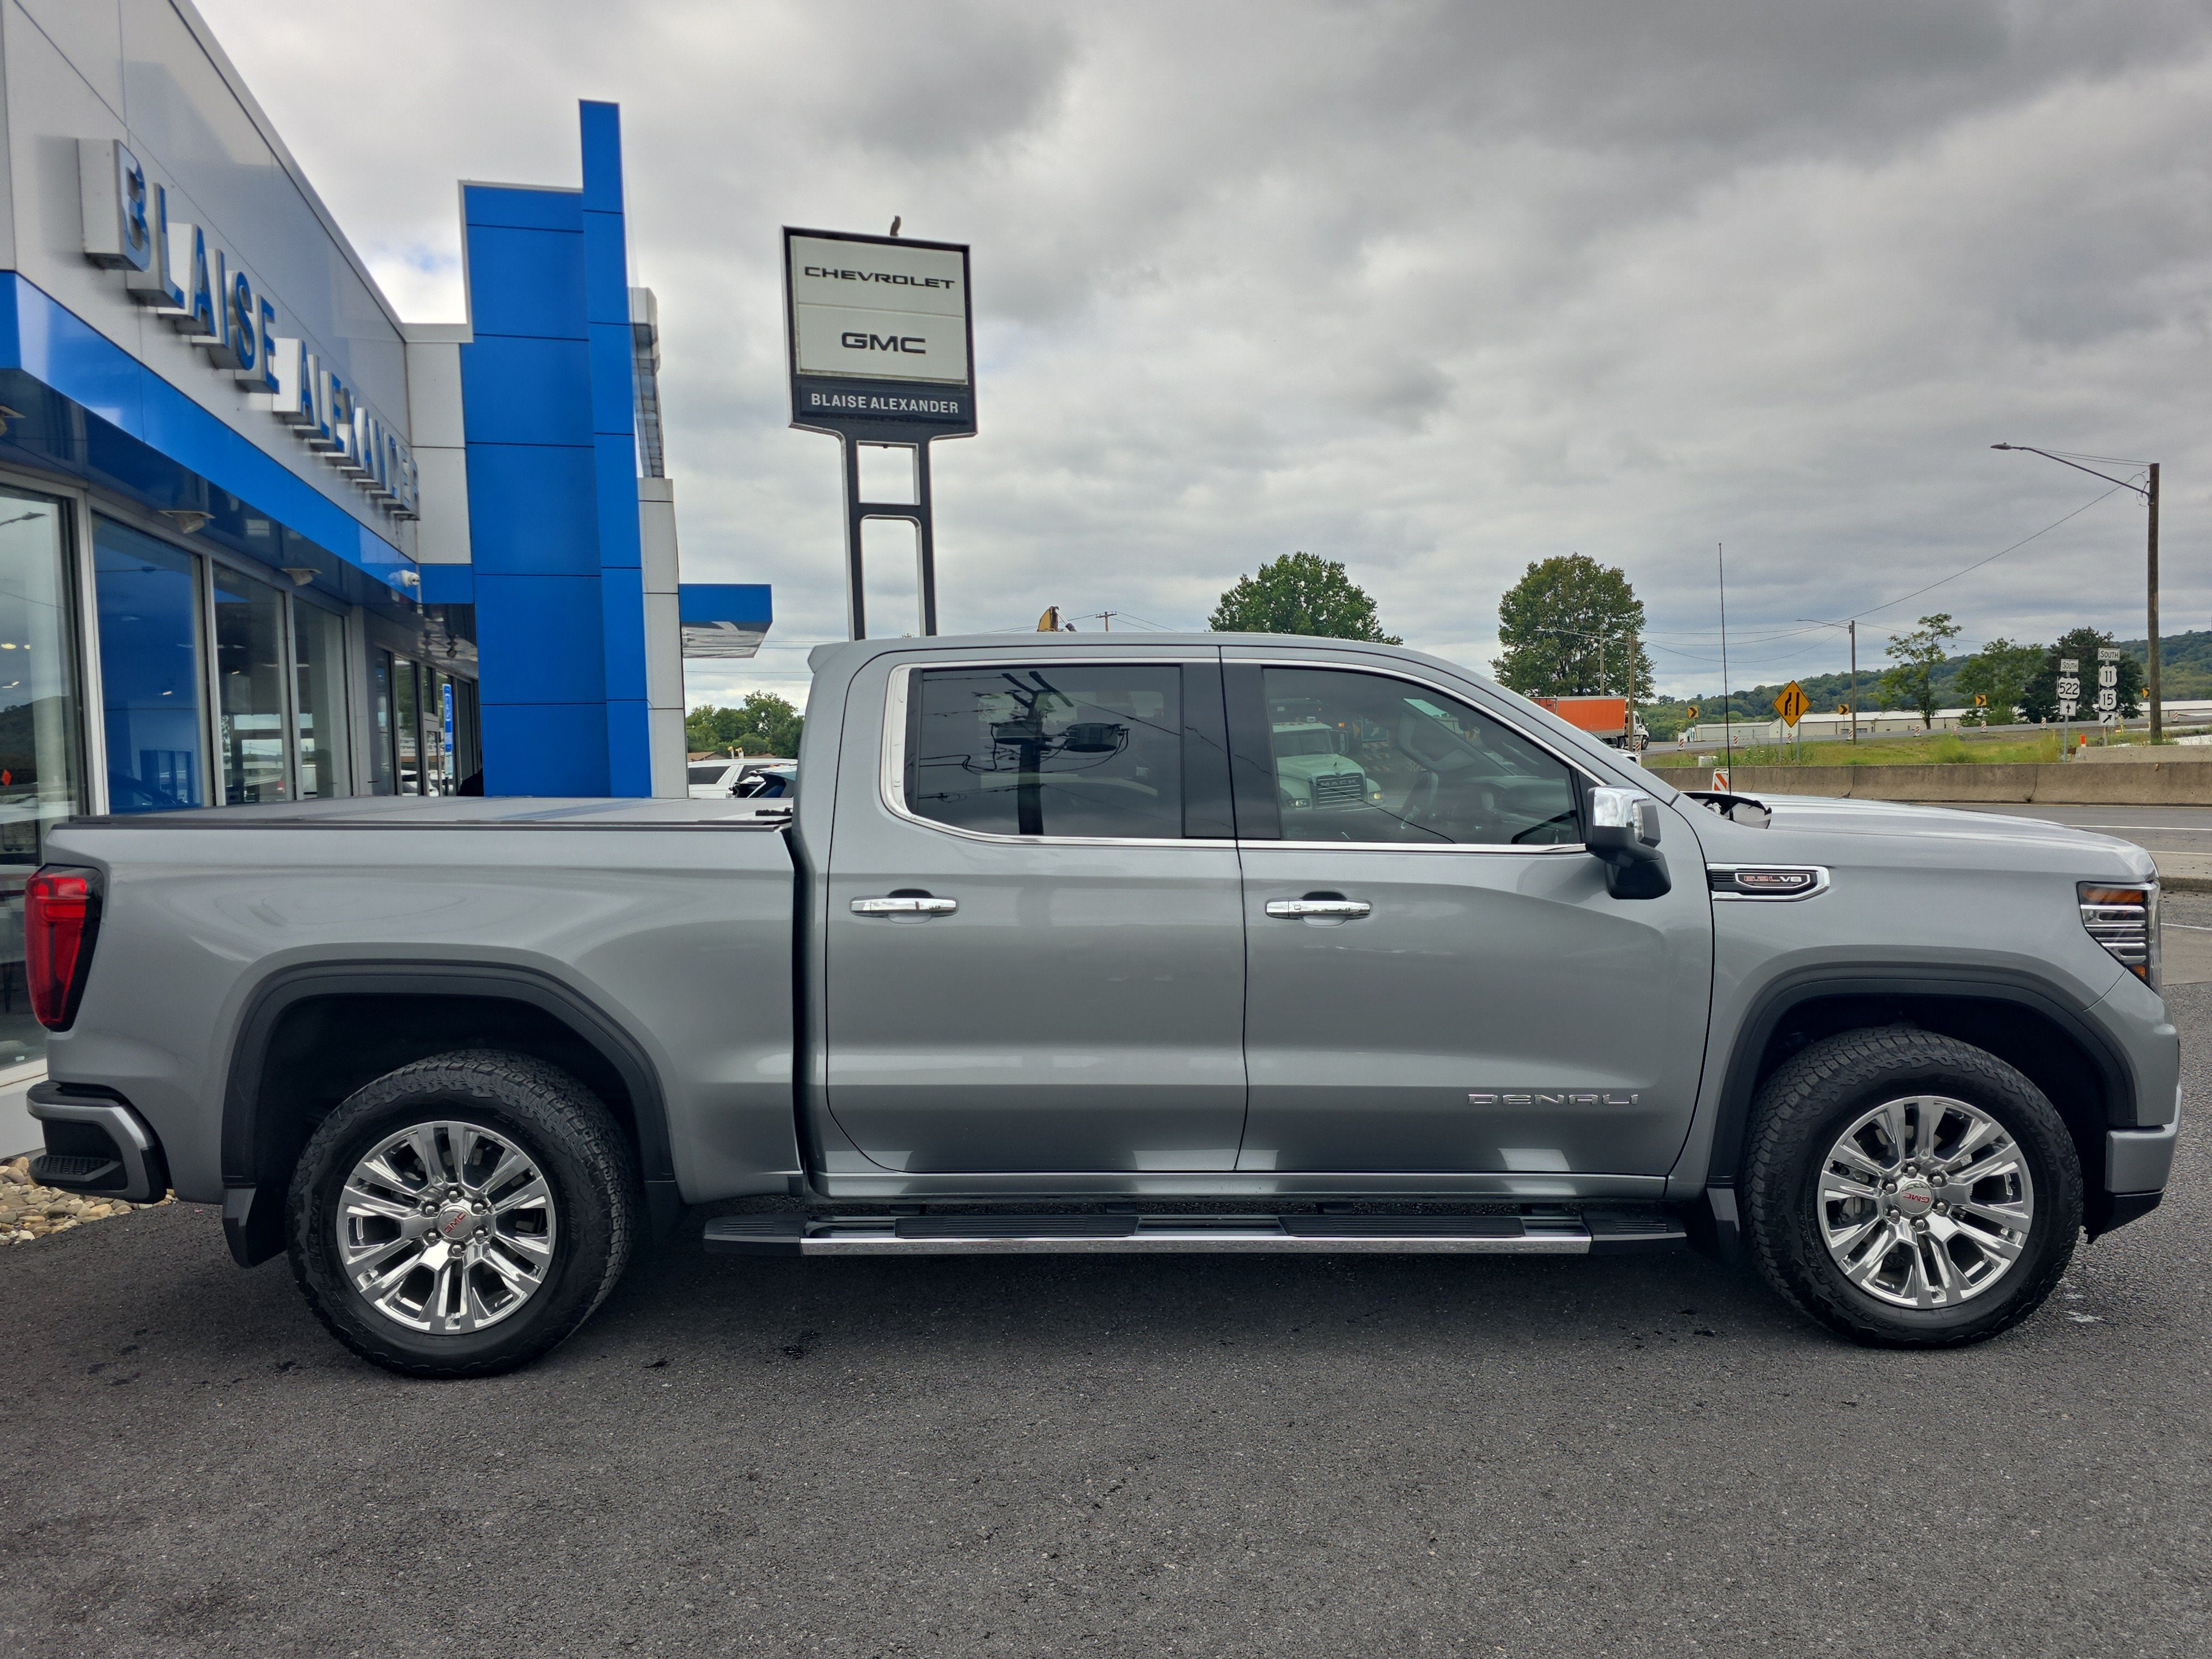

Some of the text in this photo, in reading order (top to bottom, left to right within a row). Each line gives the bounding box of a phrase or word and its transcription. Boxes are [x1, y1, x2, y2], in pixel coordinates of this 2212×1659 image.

[98, 139, 280, 394] BLAISE
[804, 266, 955, 289] CHEVROLET
[841, 331, 927, 354] GMC
[811, 393, 959, 414] BLAISE ALEXANDER
[2063, 661, 2077, 670] SOUTH
[2105, 671, 2112, 682] 11
[2060, 683, 2079, 695] 522
[2104, 694, 2113, 705] 15
[1468, 1094, 1639, 1106] DENALI
[1902, 1191, 1930, 1204] GMC
[443, 1211, 467, 1234] GMC
